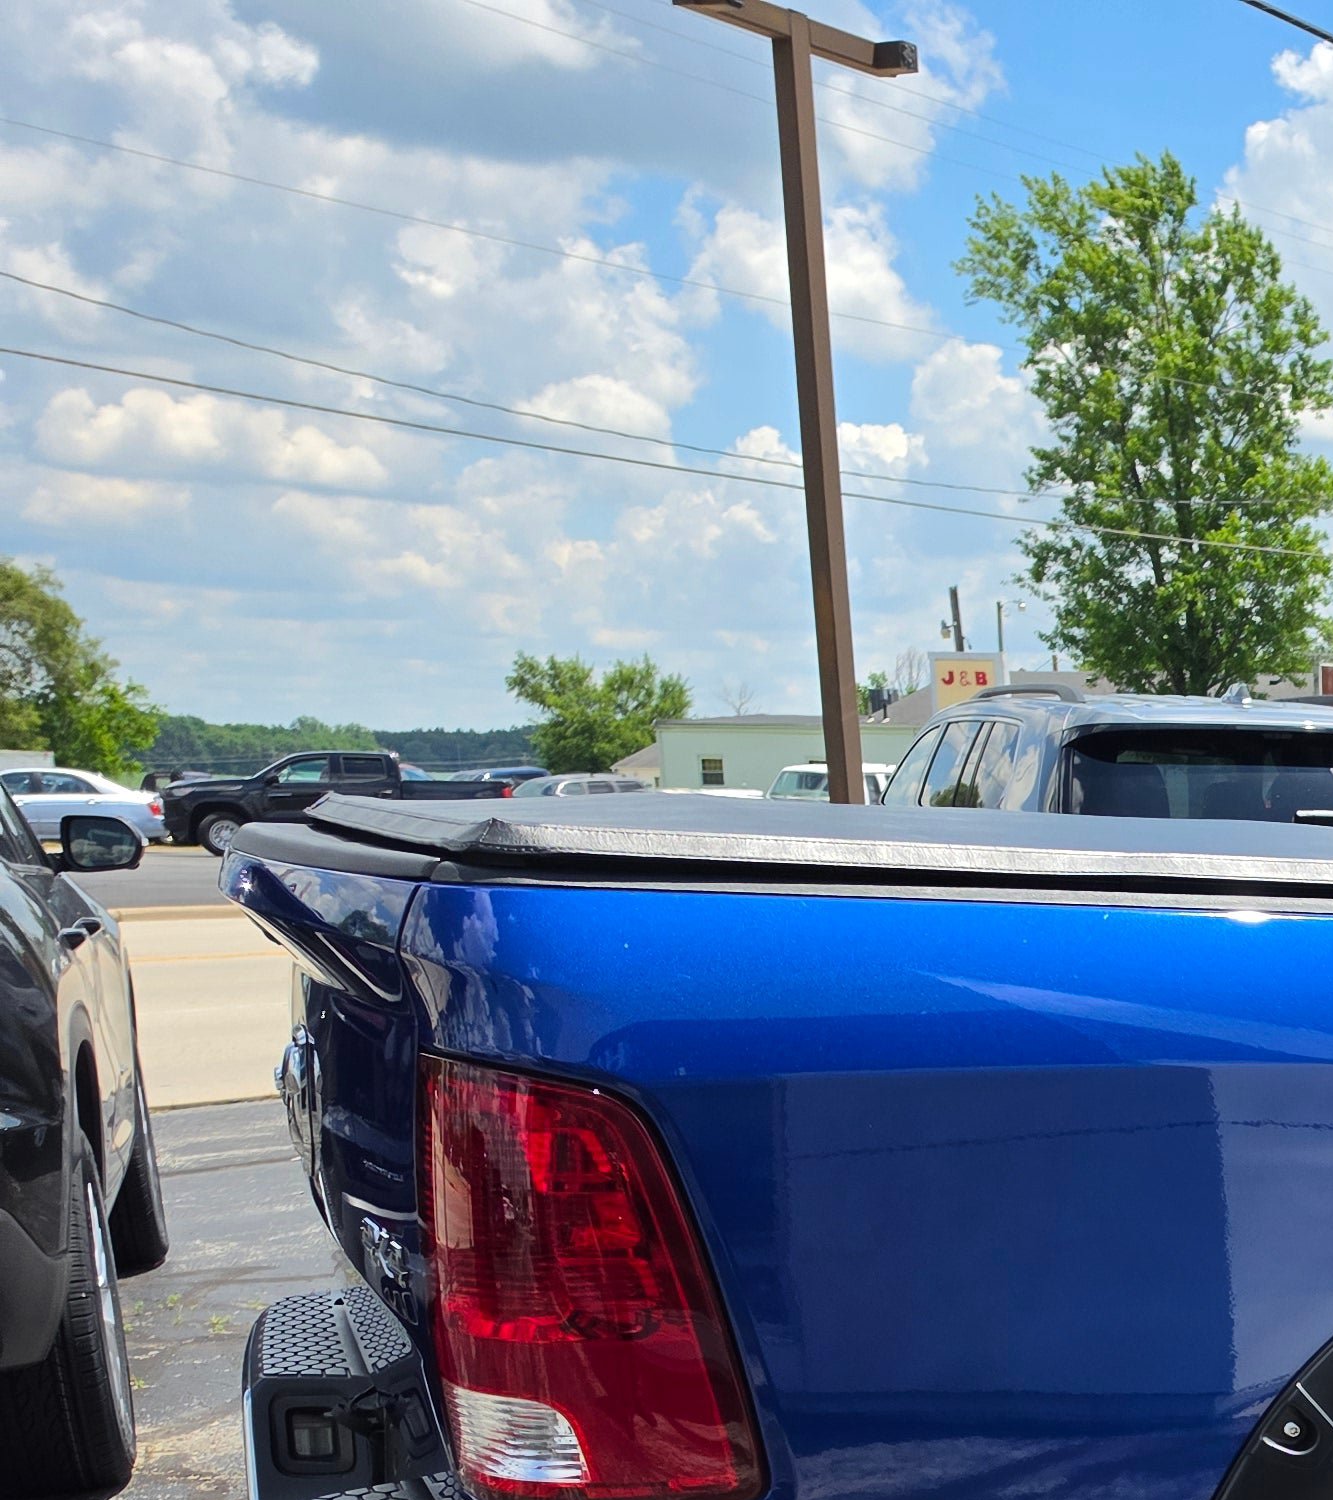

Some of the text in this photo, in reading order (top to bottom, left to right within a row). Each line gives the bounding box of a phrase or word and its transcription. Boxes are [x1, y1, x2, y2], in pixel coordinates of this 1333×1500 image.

[941, 670, 988, 687] J & B
